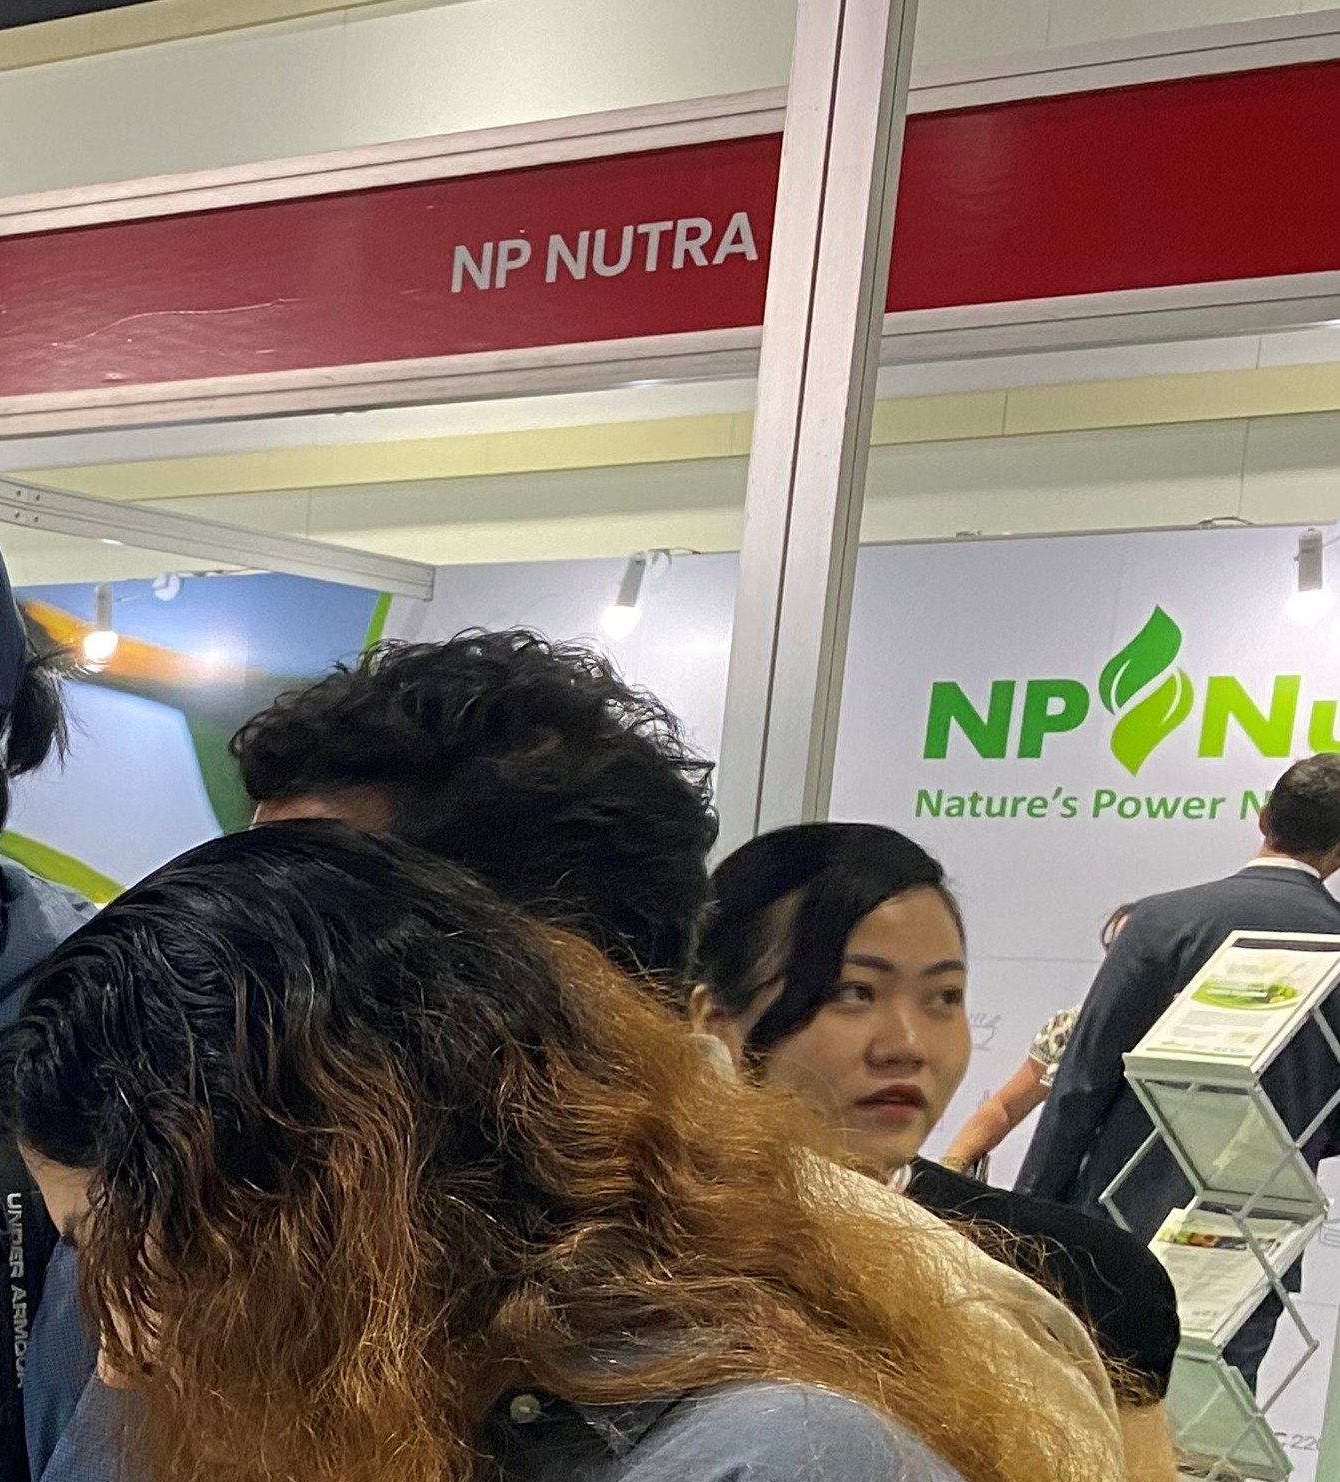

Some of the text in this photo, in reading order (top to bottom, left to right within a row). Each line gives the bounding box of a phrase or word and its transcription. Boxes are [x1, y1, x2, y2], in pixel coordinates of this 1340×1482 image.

[451, 211, 758, 293] NP NUTRA
[923, 678, 1091, 760] NP
[914, 787, 1078, 820] Nature's
[1091, 788, 1226, 821] Power
[6, 1192, 24, 1279] UNDER
